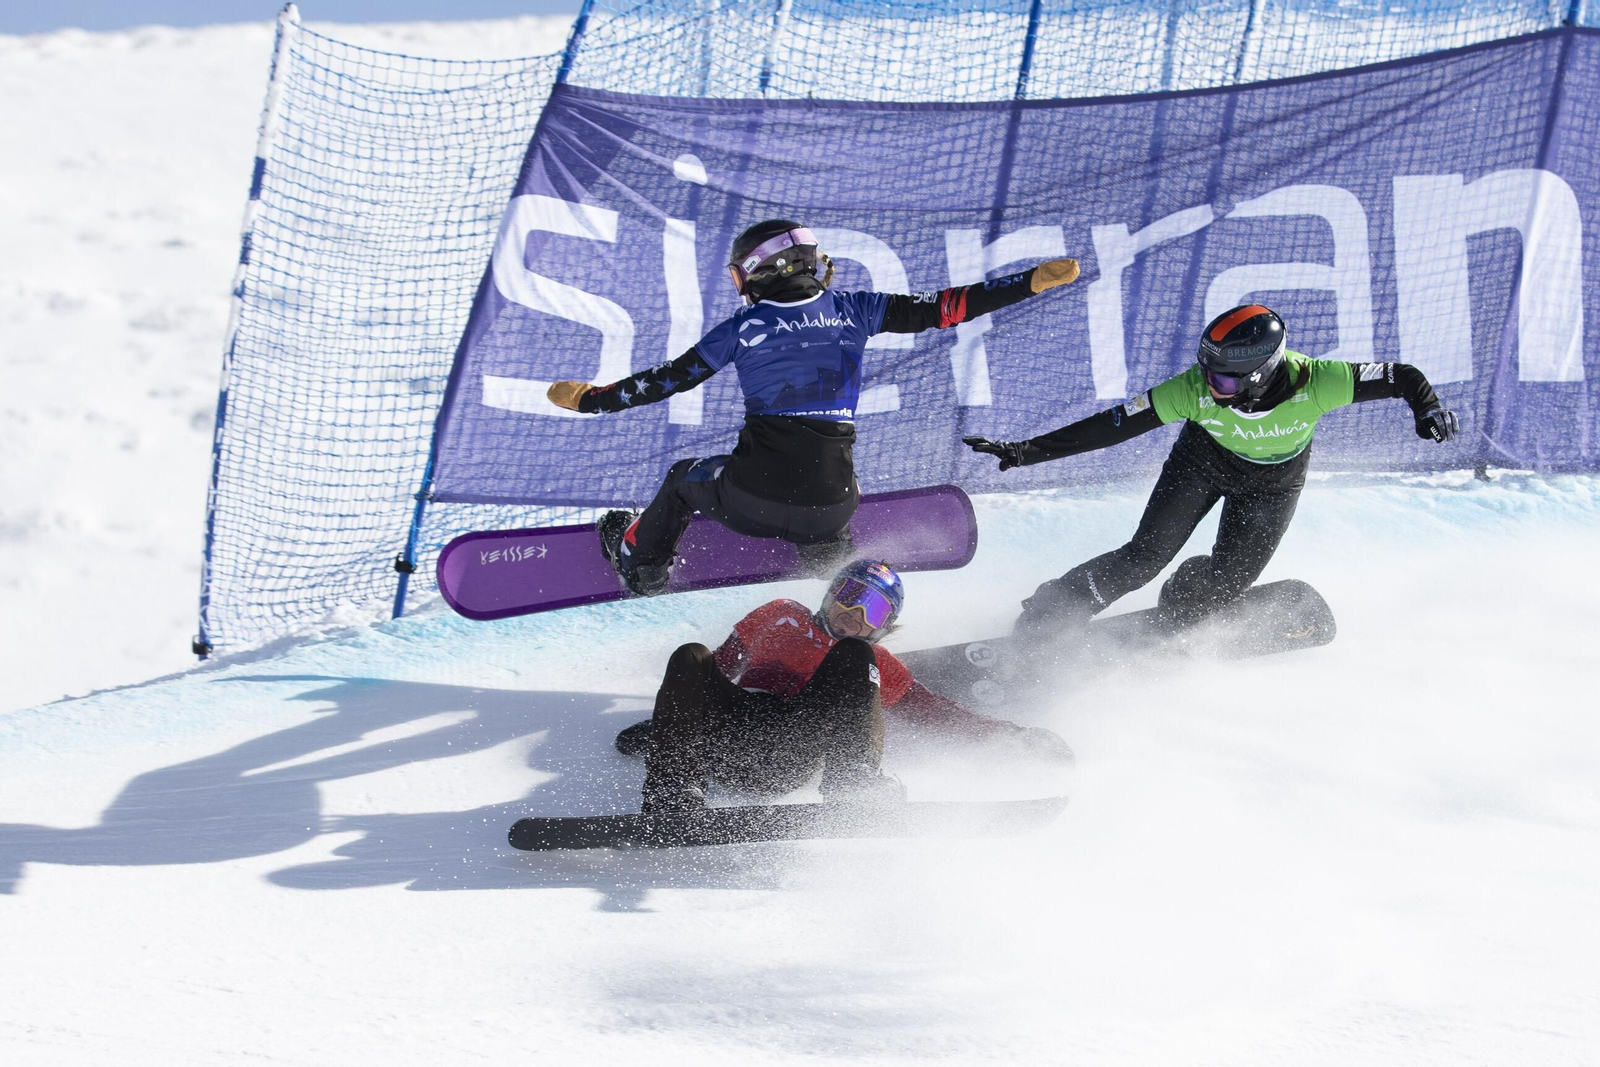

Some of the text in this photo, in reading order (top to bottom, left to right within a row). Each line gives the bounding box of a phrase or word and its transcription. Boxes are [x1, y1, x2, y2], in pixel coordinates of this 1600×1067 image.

[774, 311, 857, 334] Andalucía
[1227, 342, 1277, 357] BREMONT
[1231, 419, 1309, 440] Andalucía
[480, 543, 548, 566] KESSLER
[1086, 571, 1106, 604] KARBON
